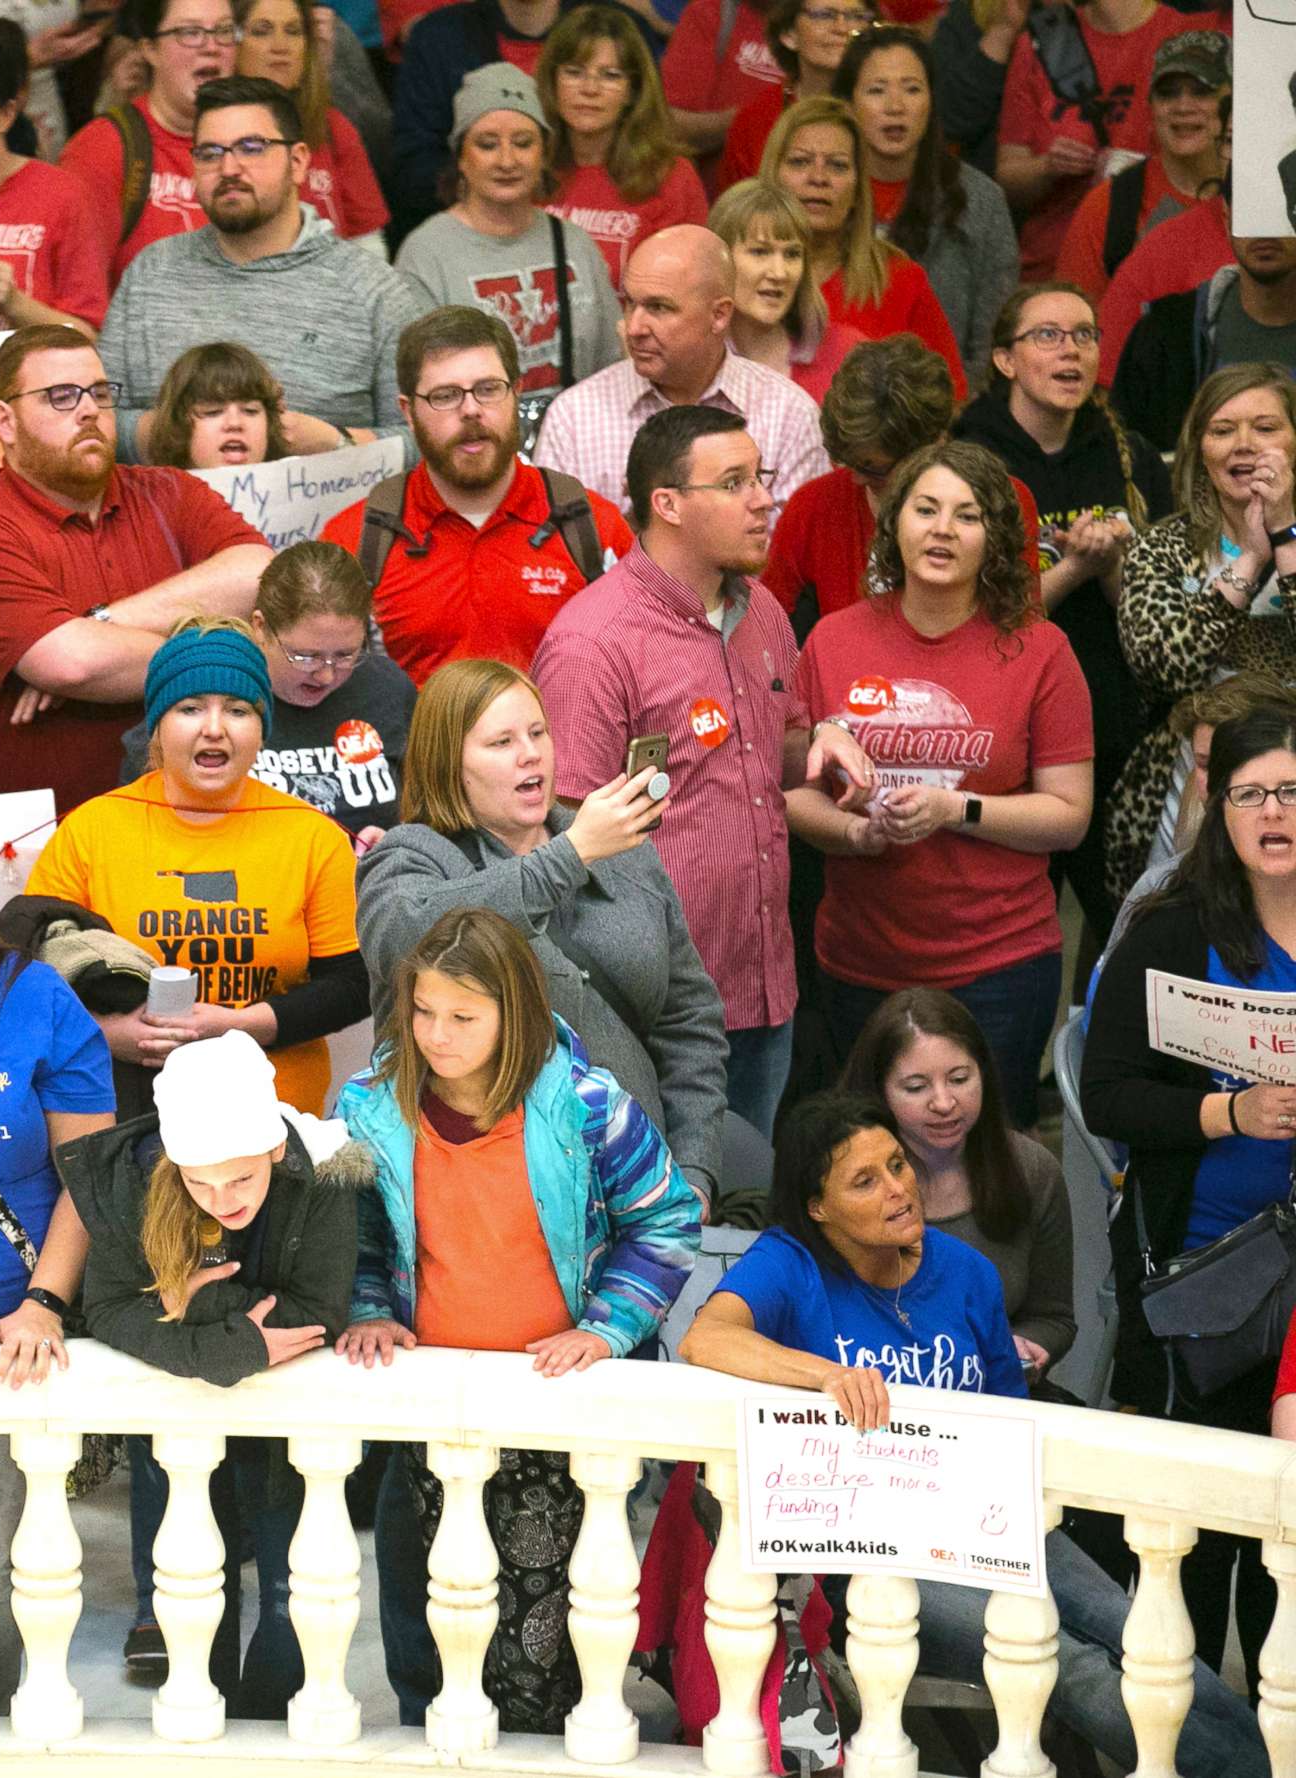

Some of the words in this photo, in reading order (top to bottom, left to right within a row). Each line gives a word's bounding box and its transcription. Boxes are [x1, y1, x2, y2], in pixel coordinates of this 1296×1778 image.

[230, 472, 271, 518] My
[848, 687, 888, 706] OEA
[692, 708, 728, 737] OEA
[855, 719, 994, 769] lahoma
[138, 907, 269, 938] ORANGE
[156, 937, 255, 965] YOU
[217, 965, 278, 1002] BEING
[1182, 990, 1236, 1010] walk
[834, 1333, 985, 1393] together
[758, 1409, 765, 1424] I
[773, 1409, 828, 1426] walk
[835, 1410, 931, 1437] buse
[855, 1438, 940, 1467] students
[765, 1464, 874, 1489] deserve
[889, 1474, 942, 1492] more
[758, 1539, 899, 1557] #OKwalk4kids
[930, 1548, 957, 1562] OEA
[970, 1554, 1031, 1571] TOGETHER
